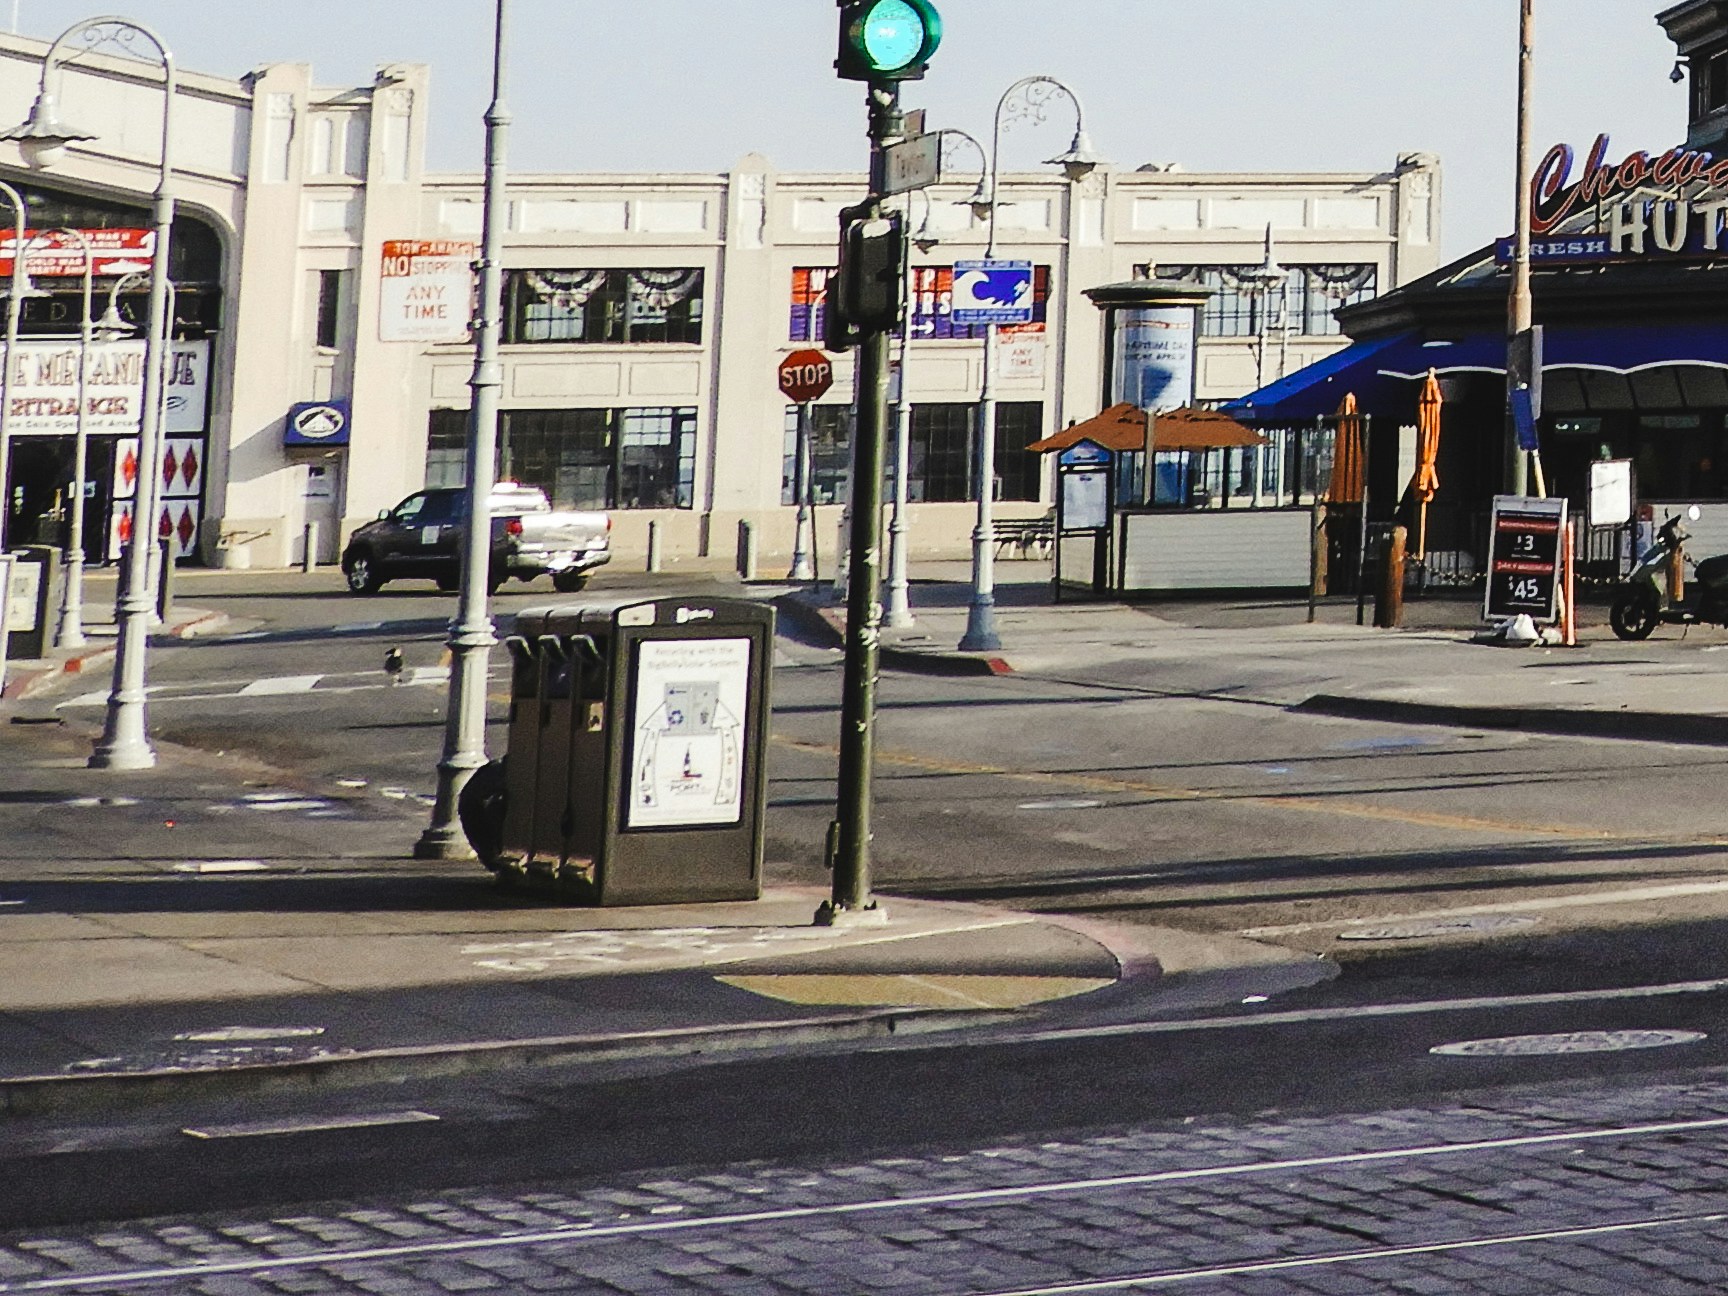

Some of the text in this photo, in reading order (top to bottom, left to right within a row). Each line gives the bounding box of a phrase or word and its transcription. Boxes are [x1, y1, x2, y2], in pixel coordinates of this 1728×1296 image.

[382, 256, 409, 276] NO
[406, 285, 446, 301] ANY
[403, 304, 448, 319] TIME
[781, 361, 829, 387] STOP
